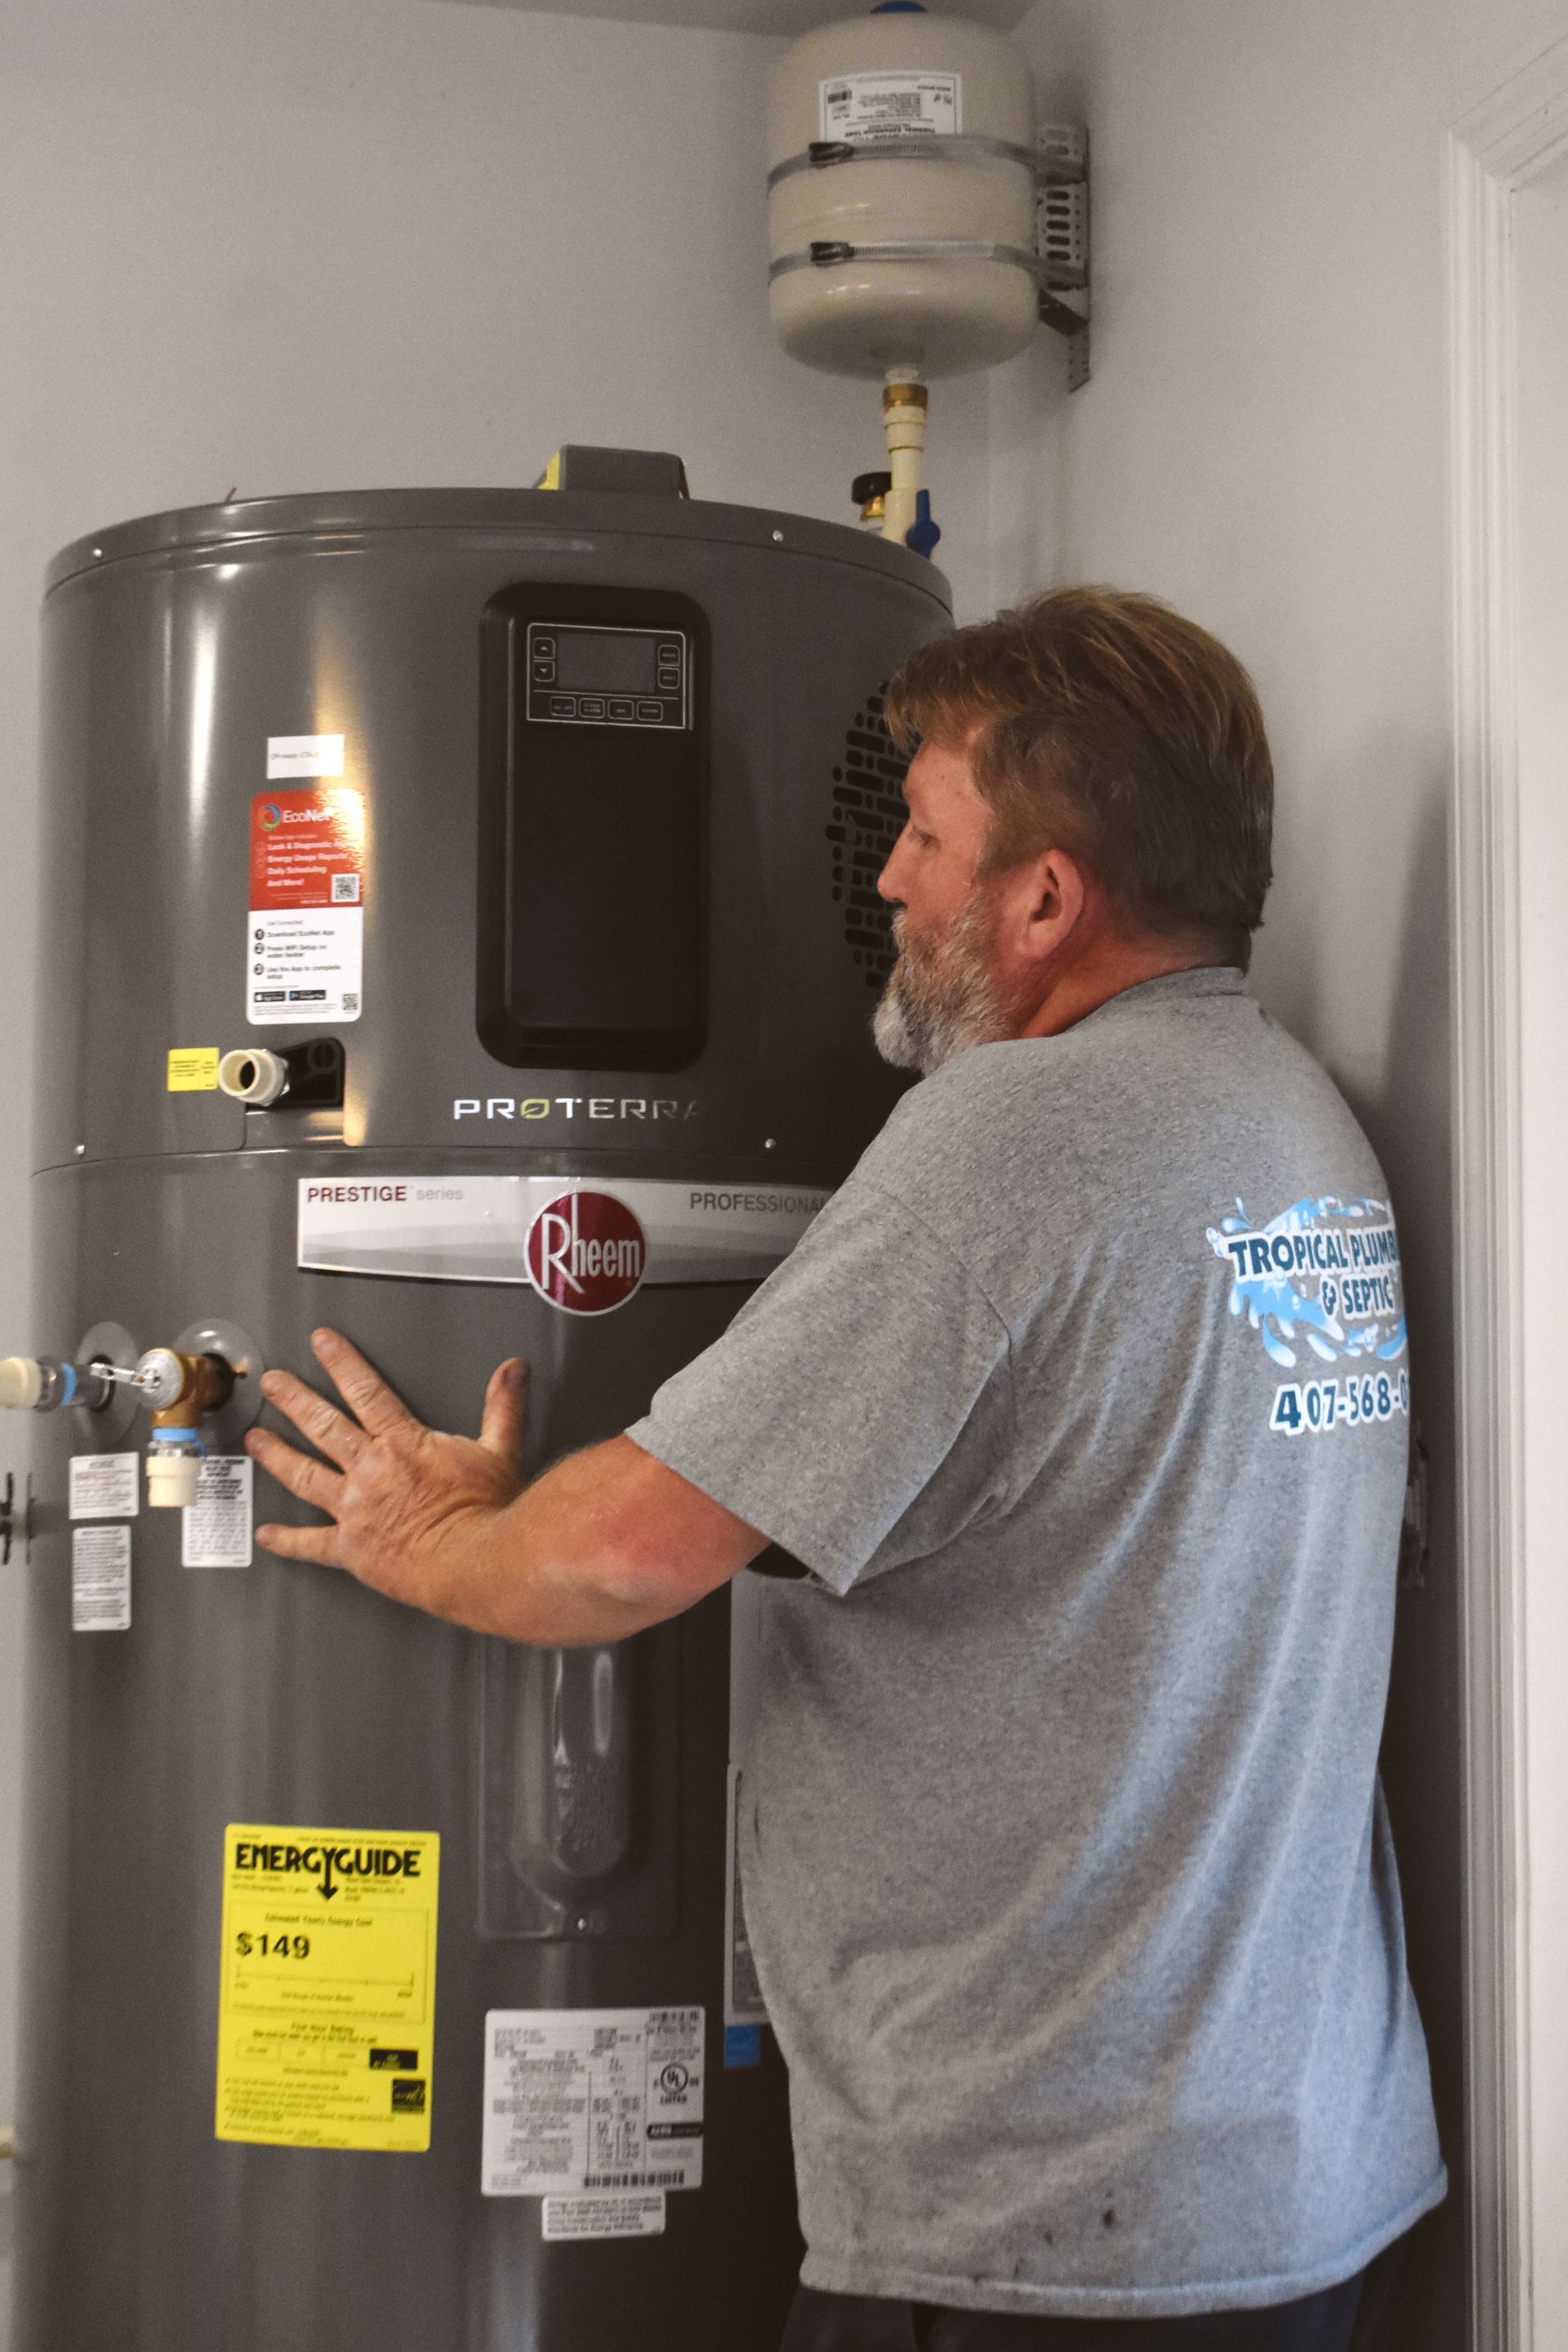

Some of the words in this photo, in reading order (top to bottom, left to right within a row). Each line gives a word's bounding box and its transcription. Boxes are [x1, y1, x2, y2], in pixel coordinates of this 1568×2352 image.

[454, 1098, 698, 1120] PROTERRA
[308, 1186, 407, 1202] PRESTIGE
[416, 1188, 464, 1201] series
[541, 1190, 640, 1294] Rheem
[1228, 1234, 1348, 1277] TROPICAL
[1321, 1281, 1337, 1316] &
[1342, 1276, 1395, 1314] SEPTIC
[236, 1931, 310, 1960] $149
